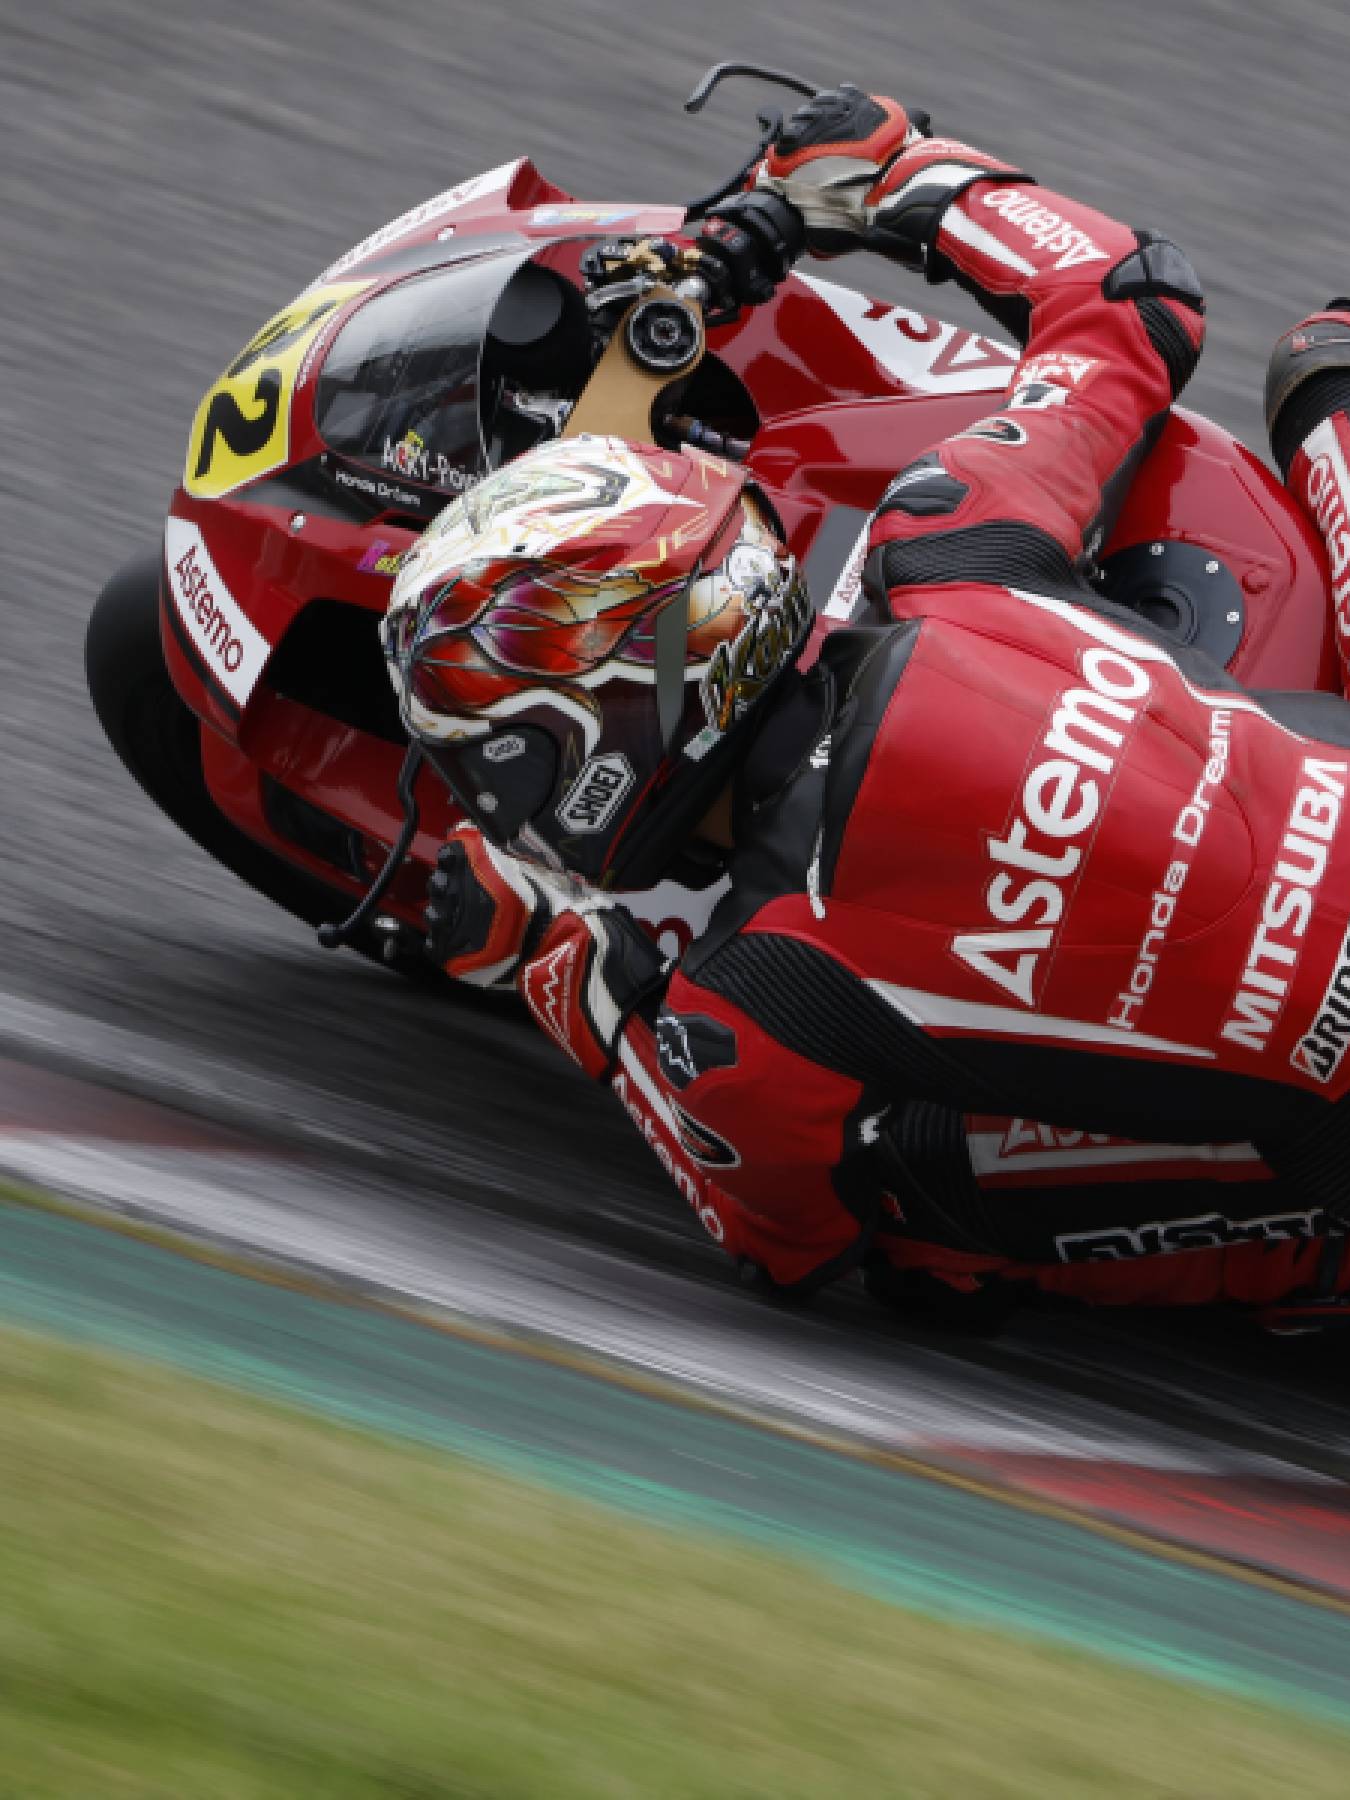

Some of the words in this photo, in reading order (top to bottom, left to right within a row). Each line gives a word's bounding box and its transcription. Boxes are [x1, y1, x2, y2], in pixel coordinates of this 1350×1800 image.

[984, 189, 1110, 271] Astemo
[174, 544, 244, 673] Astemo
[568, 764, 625, 825] SHOEI
[950, 646, 1153, 1008] Astemo
[1107, 860, 1189, 1031] Honda
[1173, 708, 1232, 845] Dream
[1220, 755, 1350, 1051] MITSUBA
